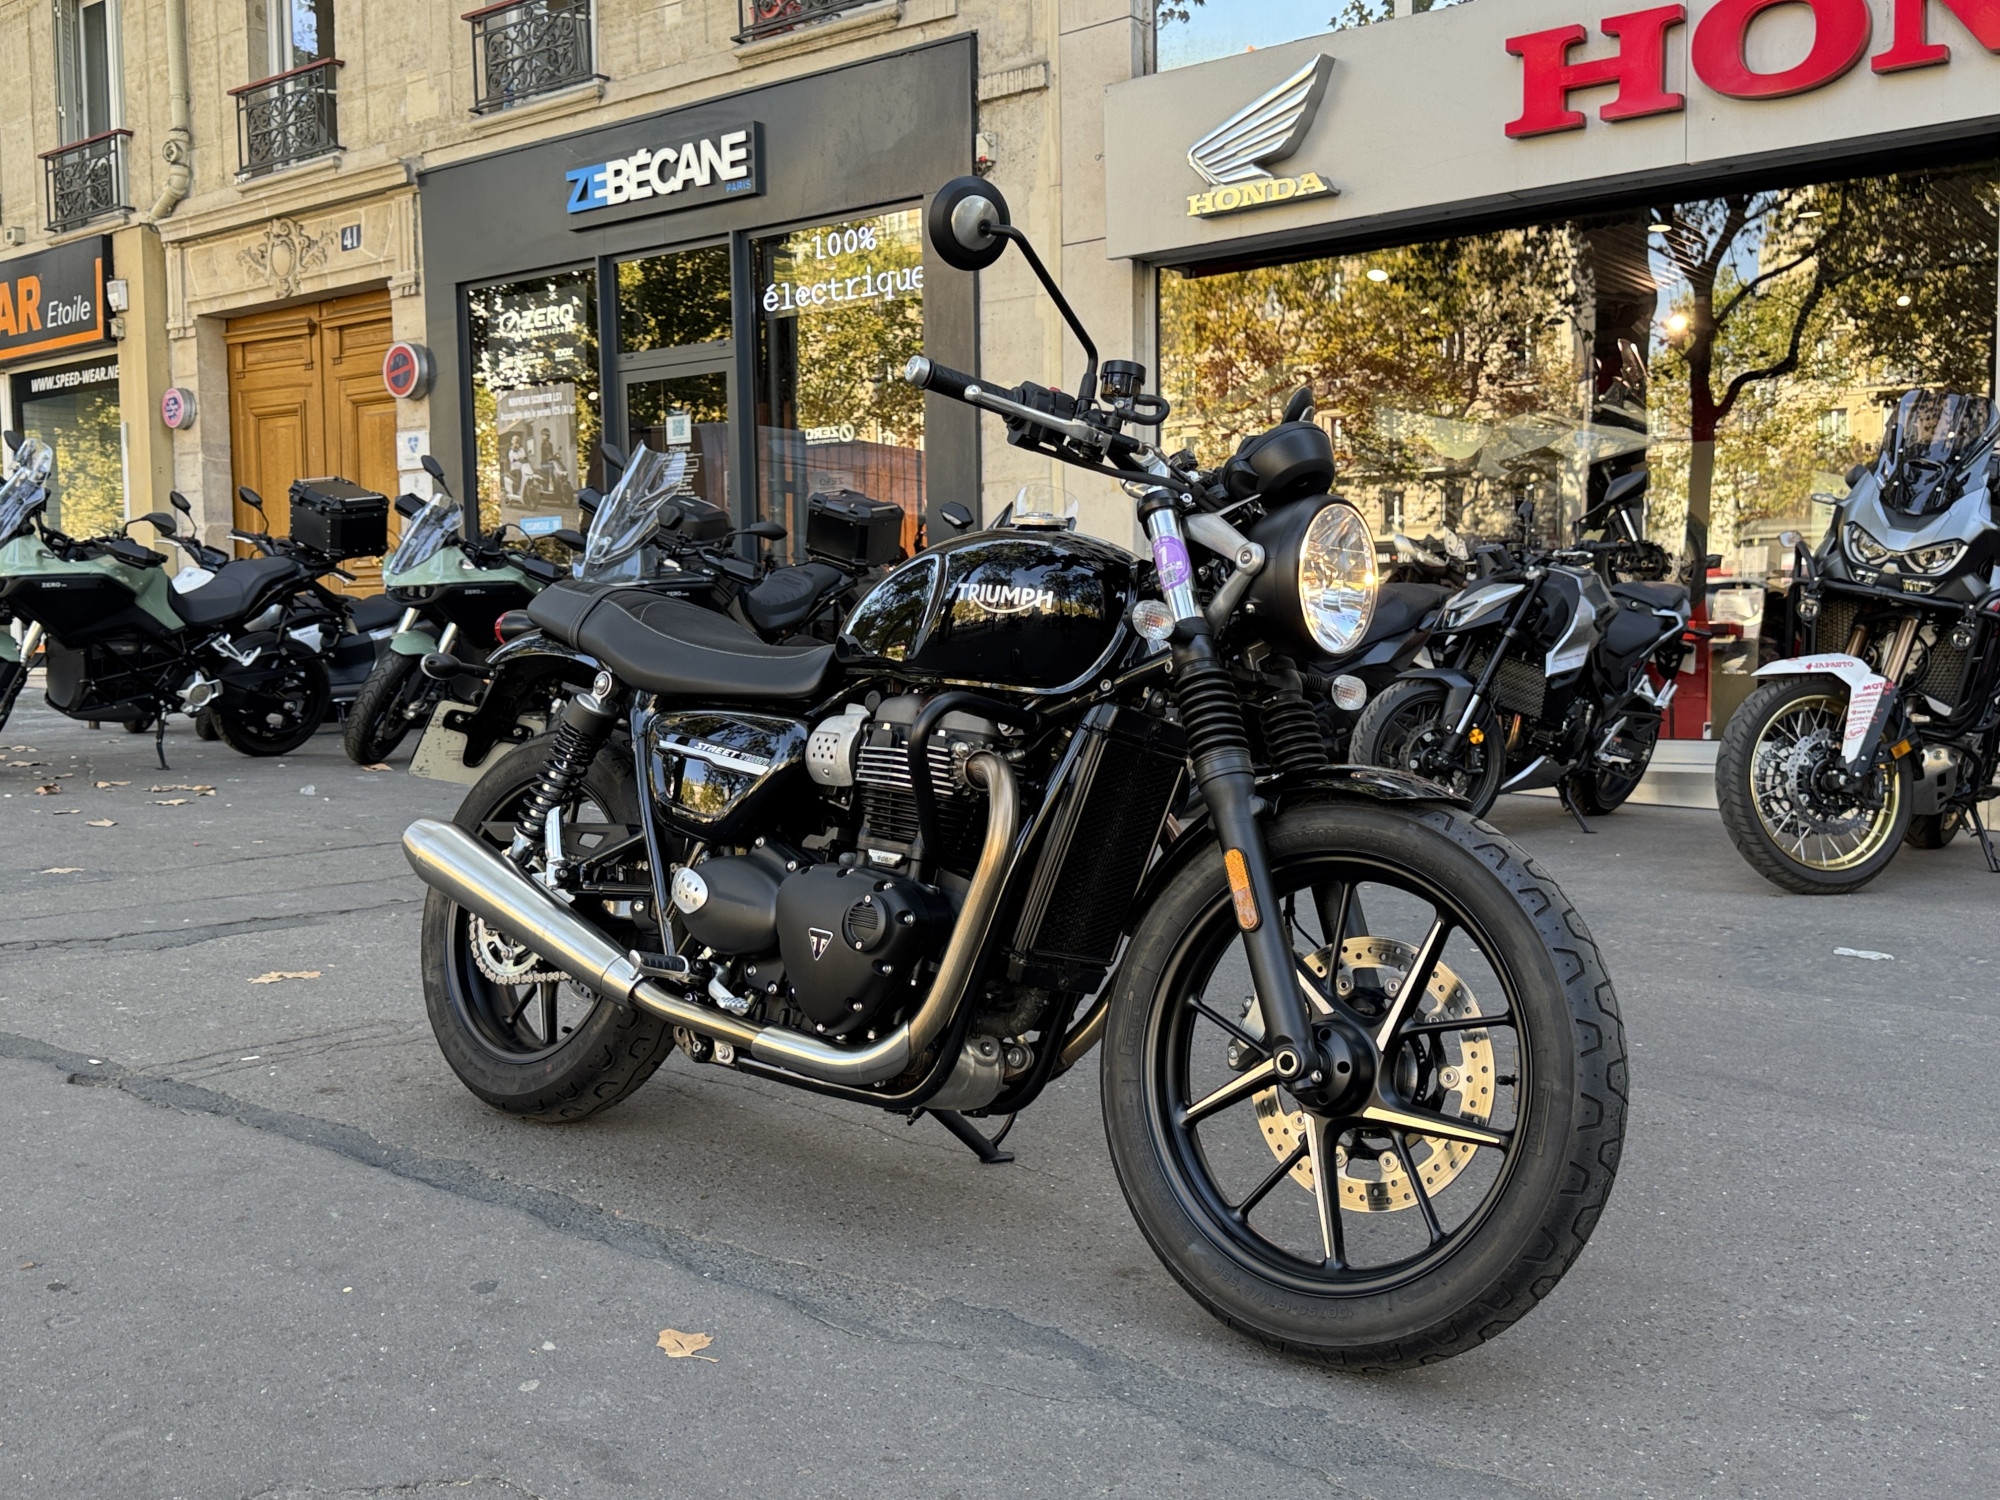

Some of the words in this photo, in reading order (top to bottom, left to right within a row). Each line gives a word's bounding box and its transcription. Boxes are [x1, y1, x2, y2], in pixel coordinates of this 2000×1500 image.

[726, 180, 751, 193] PARIS
[1186, 172, 1328, 216] HONDA
[343, 226, 358, 248] 41
[811, 226, 877, 260] 100%
[763, 265, 923, 312] électrique
[47, 295, 91, 328] Etoile
[958, 583, 1054, 612] TRIUMPH
[1863, 682, 1896, 691] MOTUL
[694, 742, 740, 758] STREET
